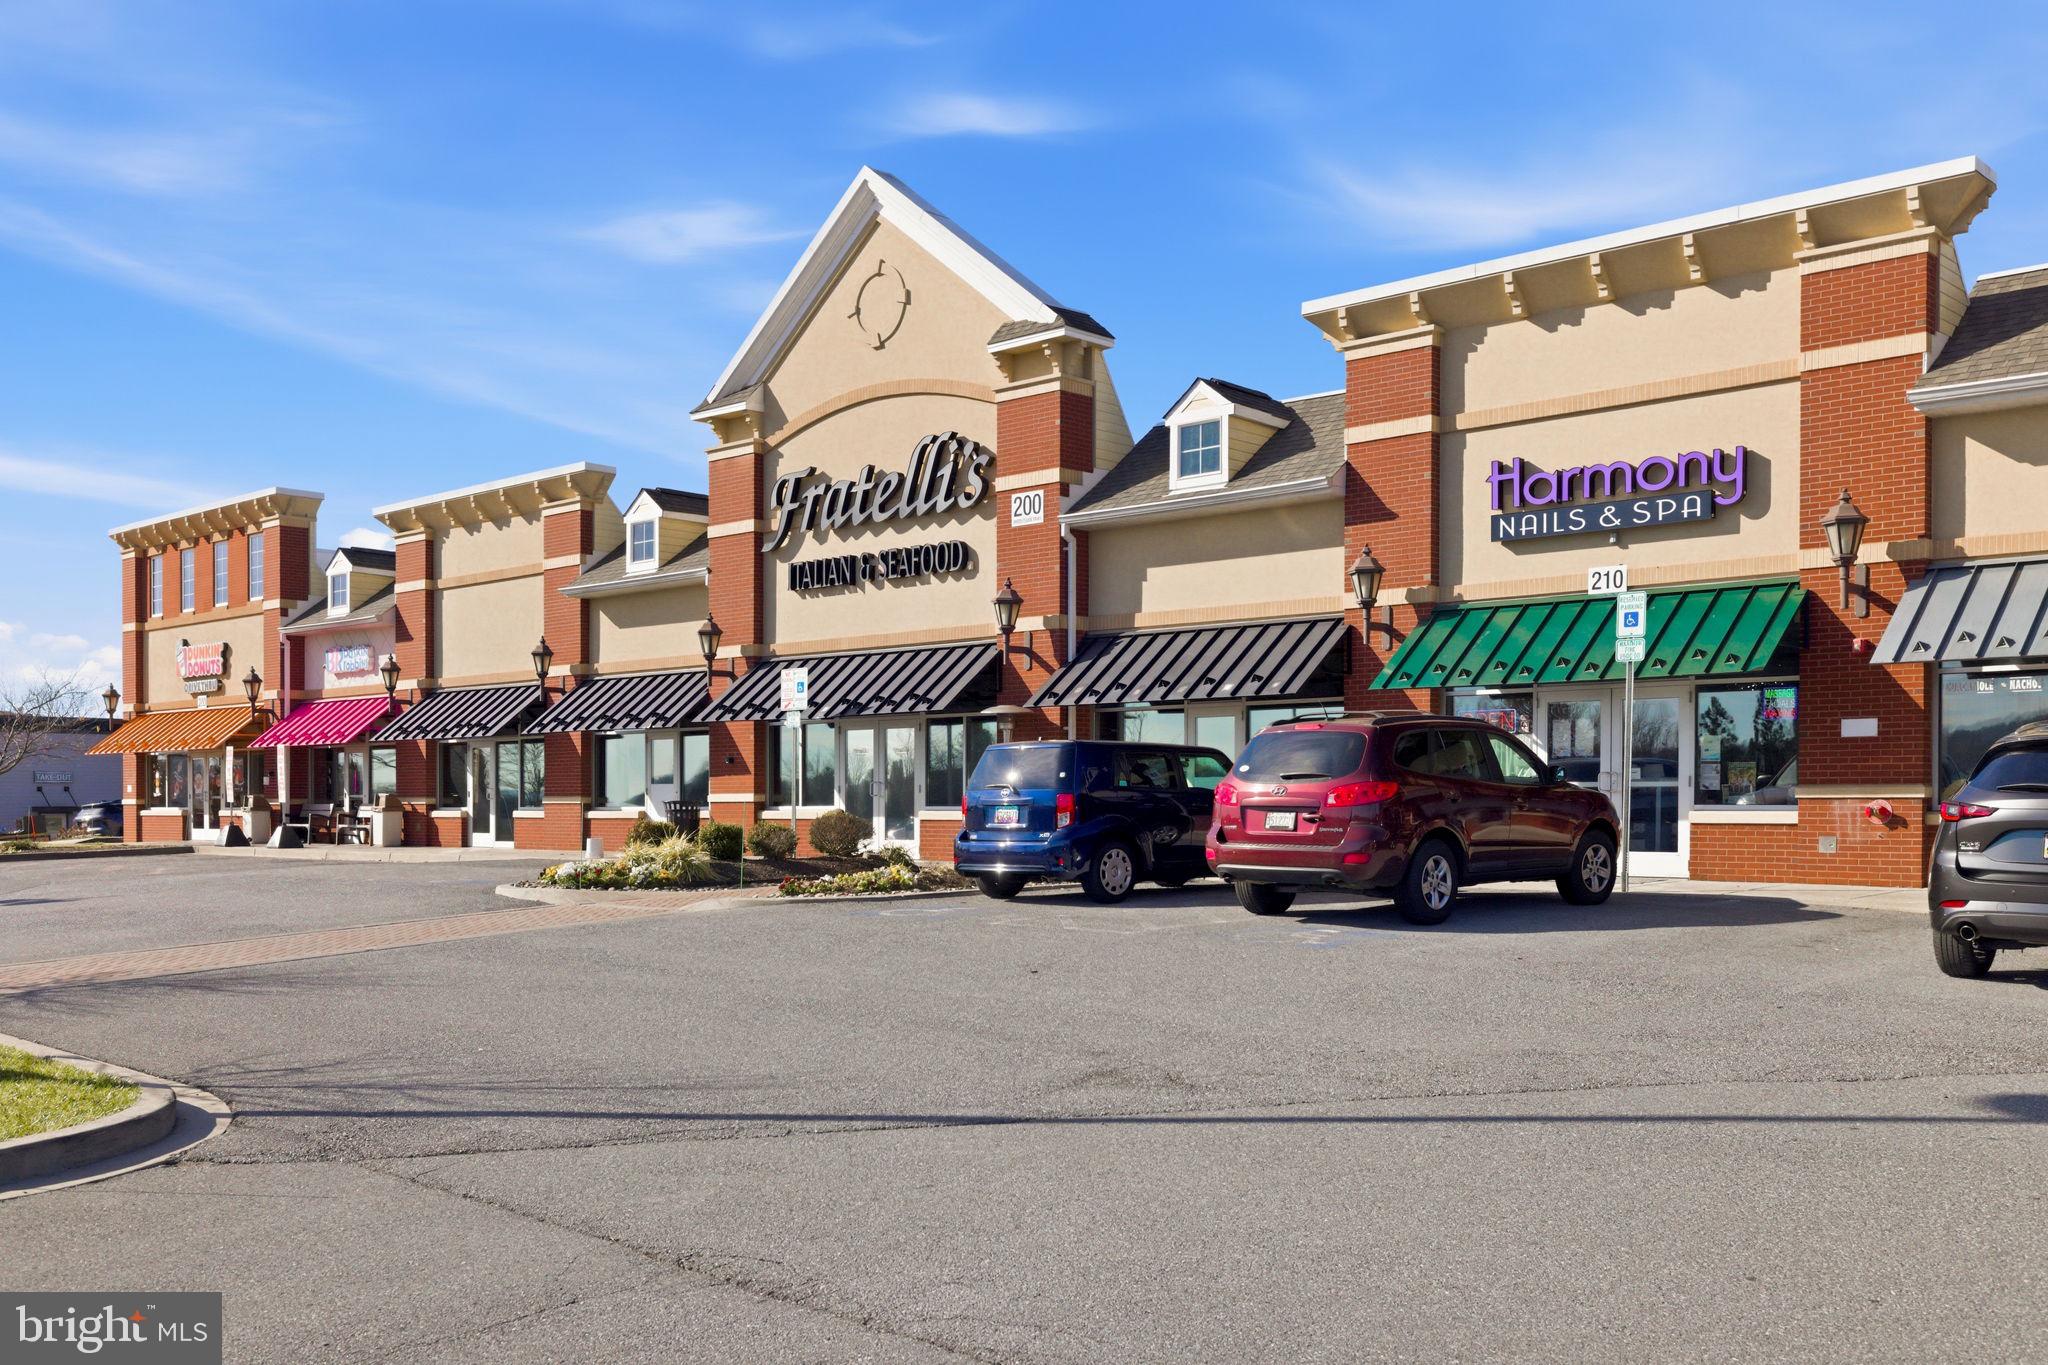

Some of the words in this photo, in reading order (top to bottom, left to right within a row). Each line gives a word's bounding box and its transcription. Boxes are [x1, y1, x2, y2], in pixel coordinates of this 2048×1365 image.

[761, 431, 995, 552] Fratelli's
[1486, 446, 1747, 510] Harmony
[1013, 493, 1042, 517] 200
[1499, 508, 1586, 539] NAILS
[1599, 506, 1621, 527] &
[1632, 495, 1702, 524] SPA
[788, 554, 858, 591] ITALIAN
[859, 553, 876, 583] &
[878, 540, 970, 581] SEAFOOD
[1591, 569, 1624, 591] 210
[187, 658, 221, 676] DONUTS
